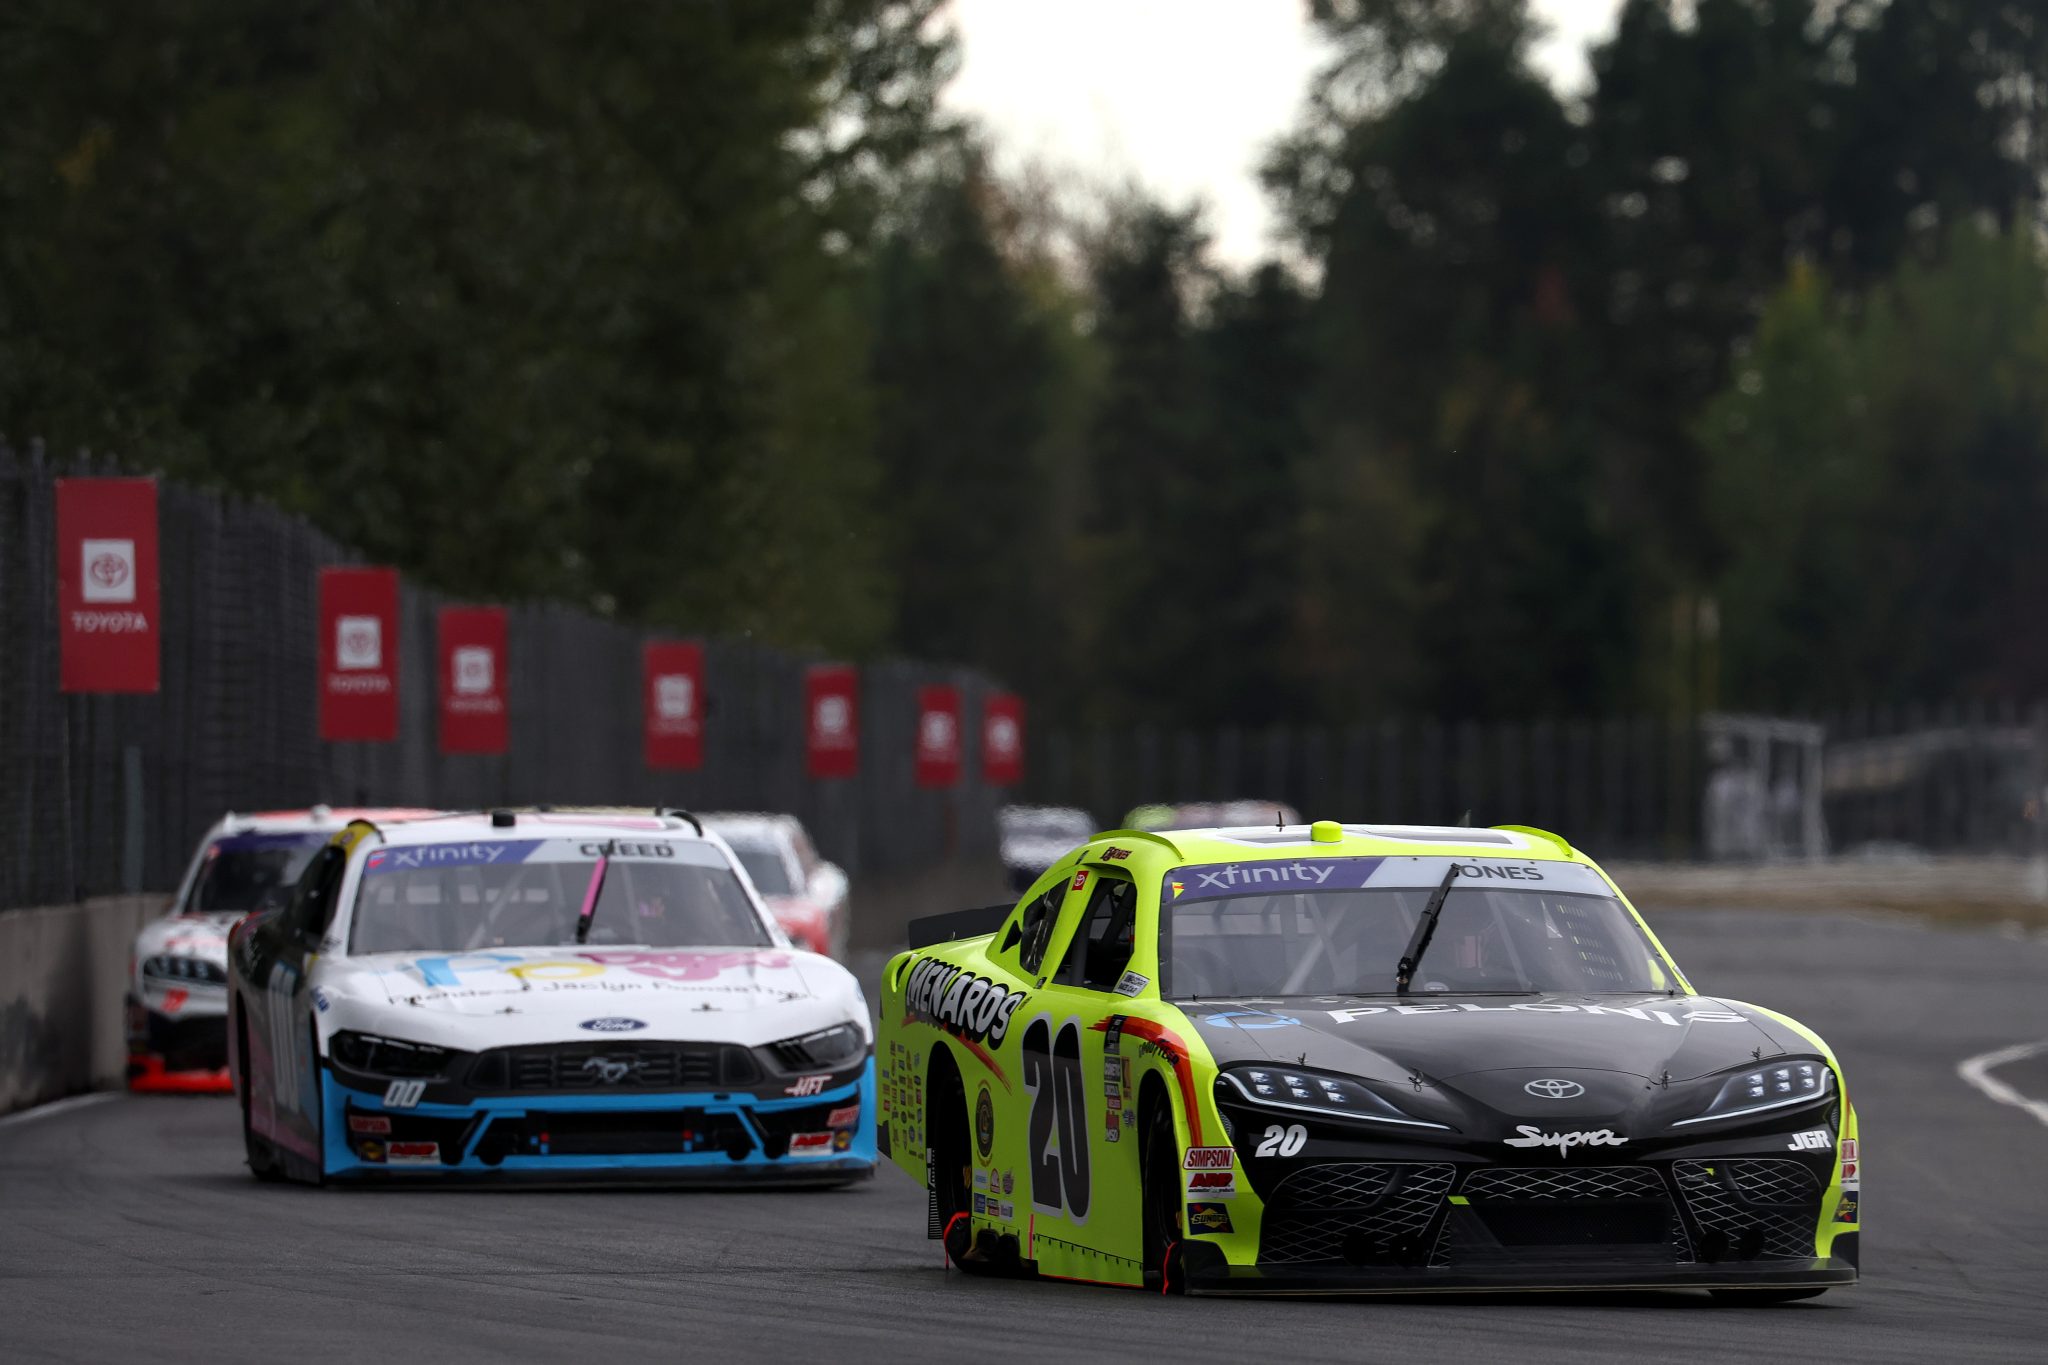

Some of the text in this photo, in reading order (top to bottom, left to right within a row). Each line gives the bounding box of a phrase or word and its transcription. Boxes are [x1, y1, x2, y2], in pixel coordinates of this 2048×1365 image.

[70, 611, 149, 633] TOYOTA
[394, 844, 504, 868] xfinity
[1196, 862, 1544, 889] xfinity ONES
[906, 958, 1026, 1043] MENARDS
[592, 1018, 633, 1031] Ford
[1326, 1003, 1749, 1026] PELONIS
[383, 1080, 427, 1108] 00
[1022, 1017, 1091, 1221] 20
[1255, 1124, 1308, 1158] 20
[1504, 1125, 1628, 1160] Supra
[1787, 1130, 1832, 1151] JGR
[1187, 1149, 1230, 1167] SIMPSON
[1189, 1173, 1233, 1187] ARP
[1192, 1213, 1228, 1226] SUNOCO
